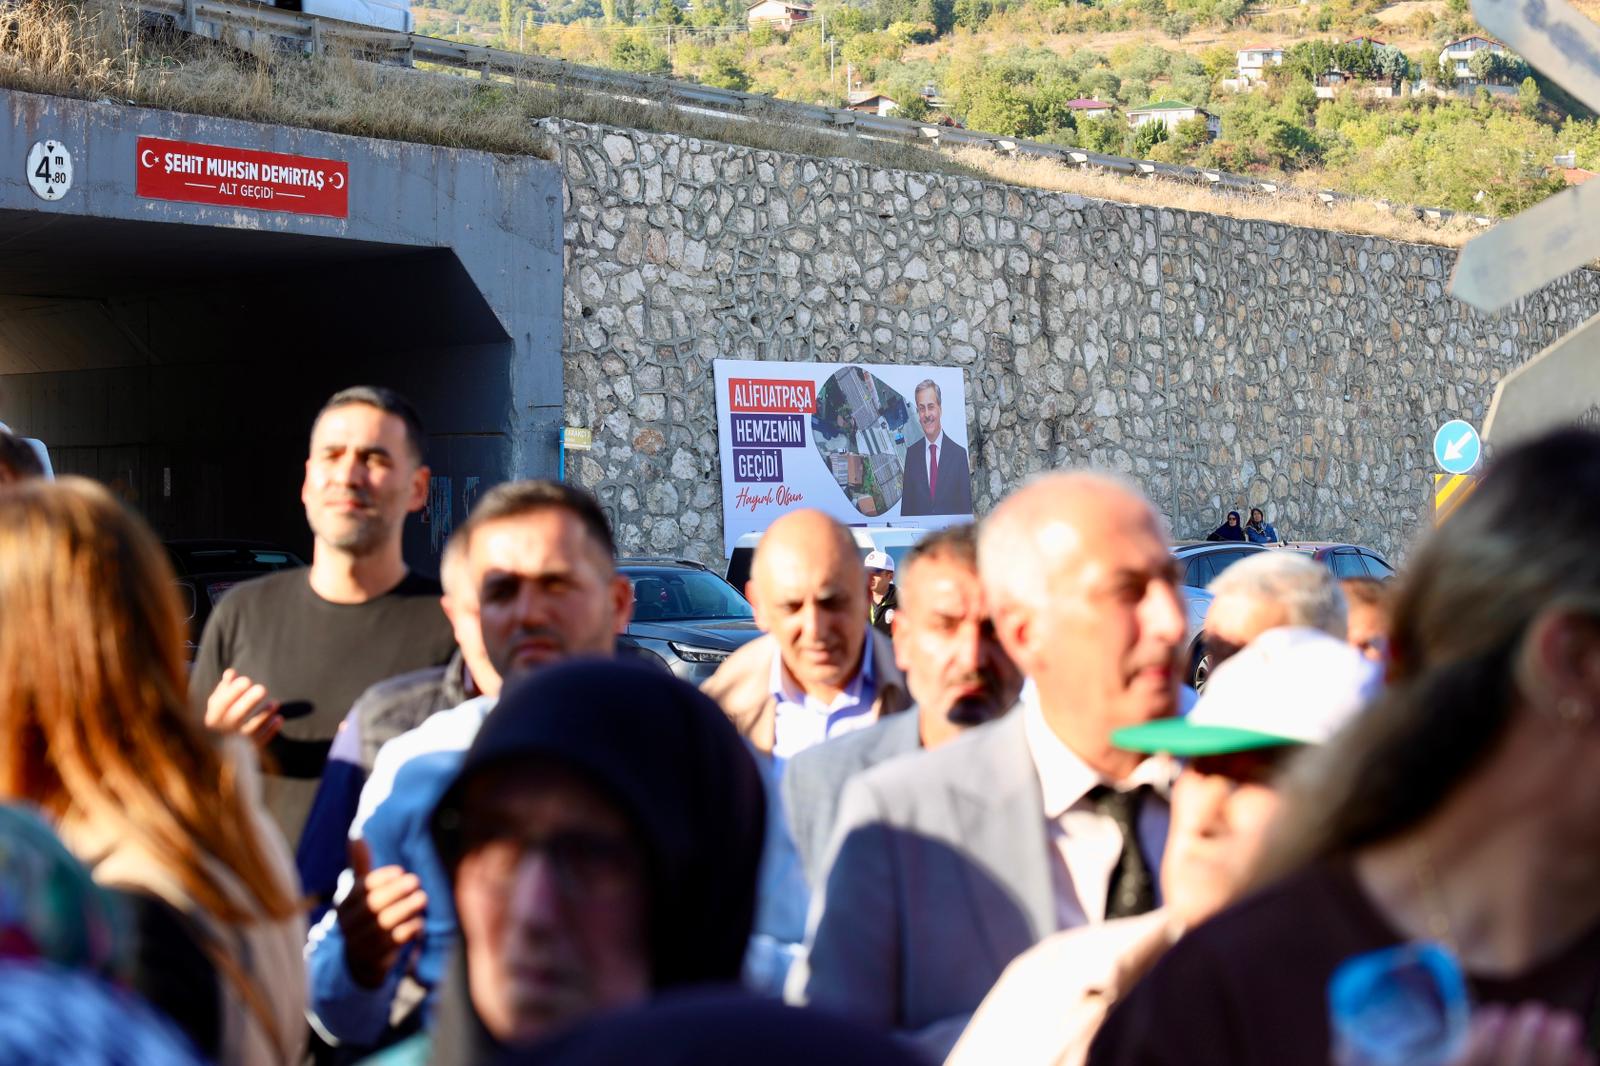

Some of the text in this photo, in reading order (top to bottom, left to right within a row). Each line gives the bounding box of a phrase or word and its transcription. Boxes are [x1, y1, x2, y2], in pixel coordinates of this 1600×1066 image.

[55, 156, 64, 165] m
[164, 152, 325, 191] ŞEHİT MUHSİN DEMİRTAŞ
[218, 182, 237, 196] ALT
[734, 380, 812, 412] ALİFUATPAŞA
[736, 416, 802, 443] HEMZEMİN
[738, 450, 779, 481] GEÇİDİ
[736, 485, 804, 512] Hayırlı Olsun
